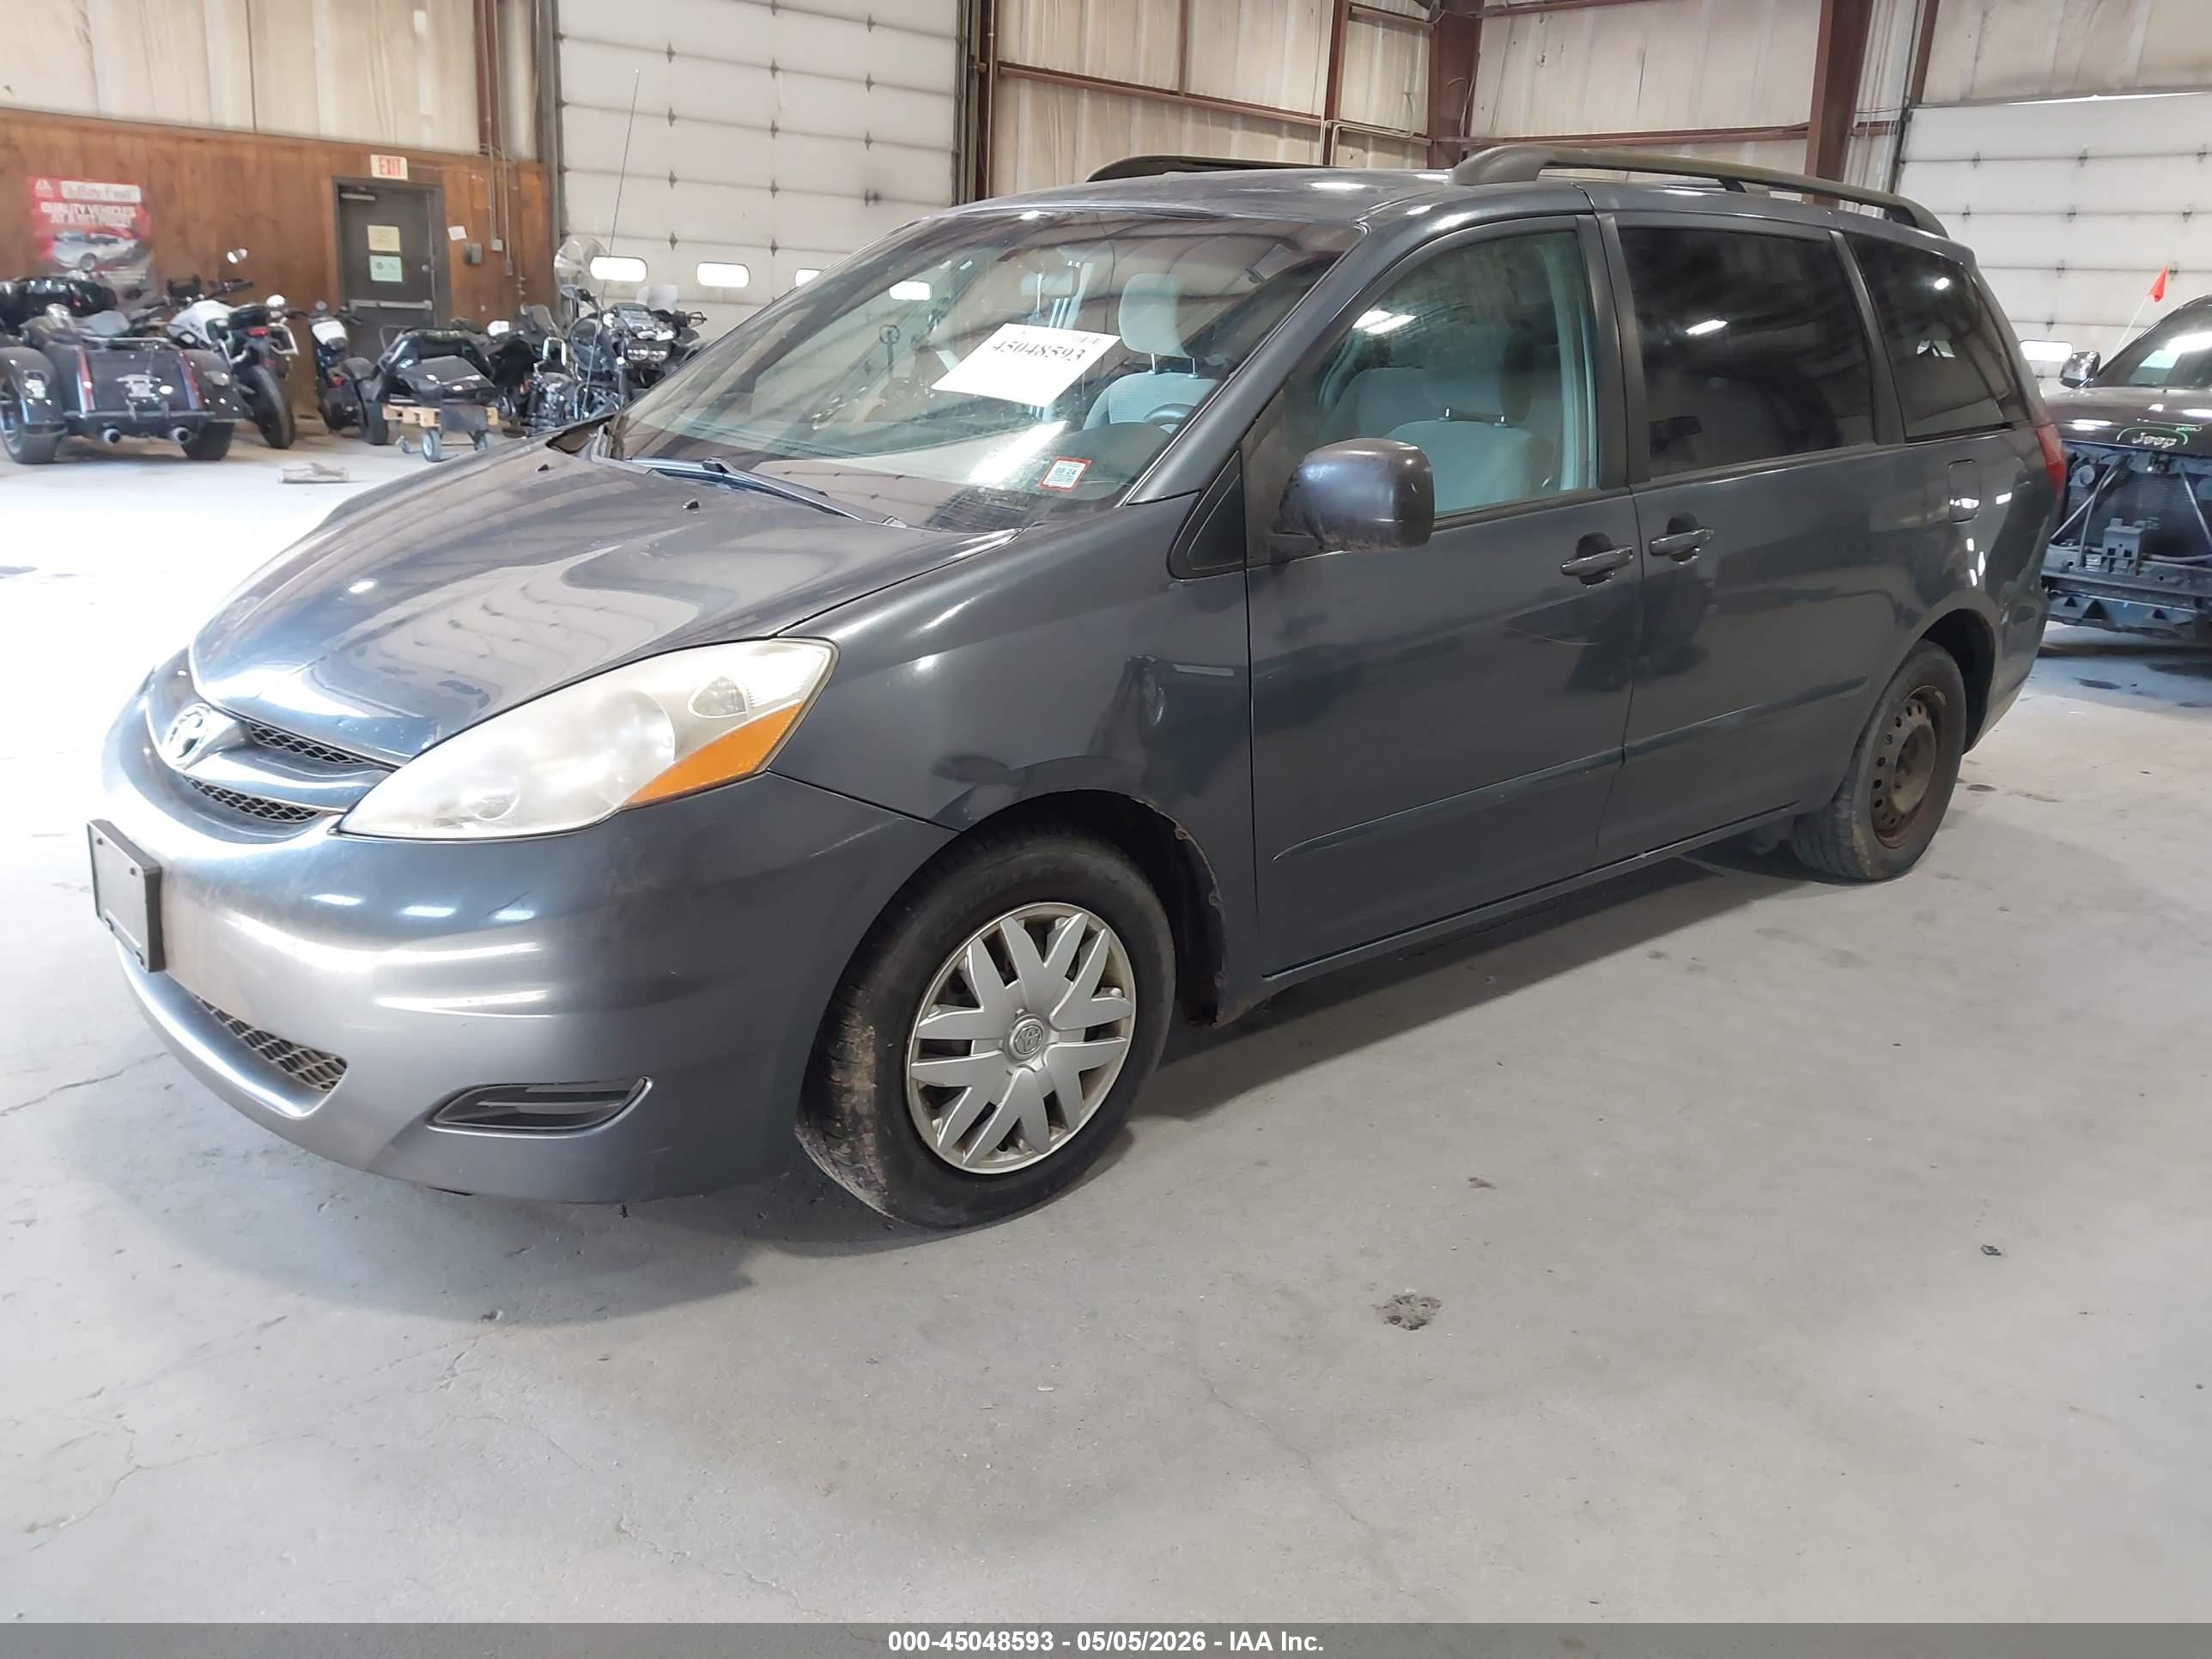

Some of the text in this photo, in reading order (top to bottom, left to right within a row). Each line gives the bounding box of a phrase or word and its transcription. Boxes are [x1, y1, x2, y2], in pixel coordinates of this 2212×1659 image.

[378, 156, 401, 176] EXIT
[991, 340, 1086, 362] 45048593
[2131, 432, 2178, 448] Jeep
